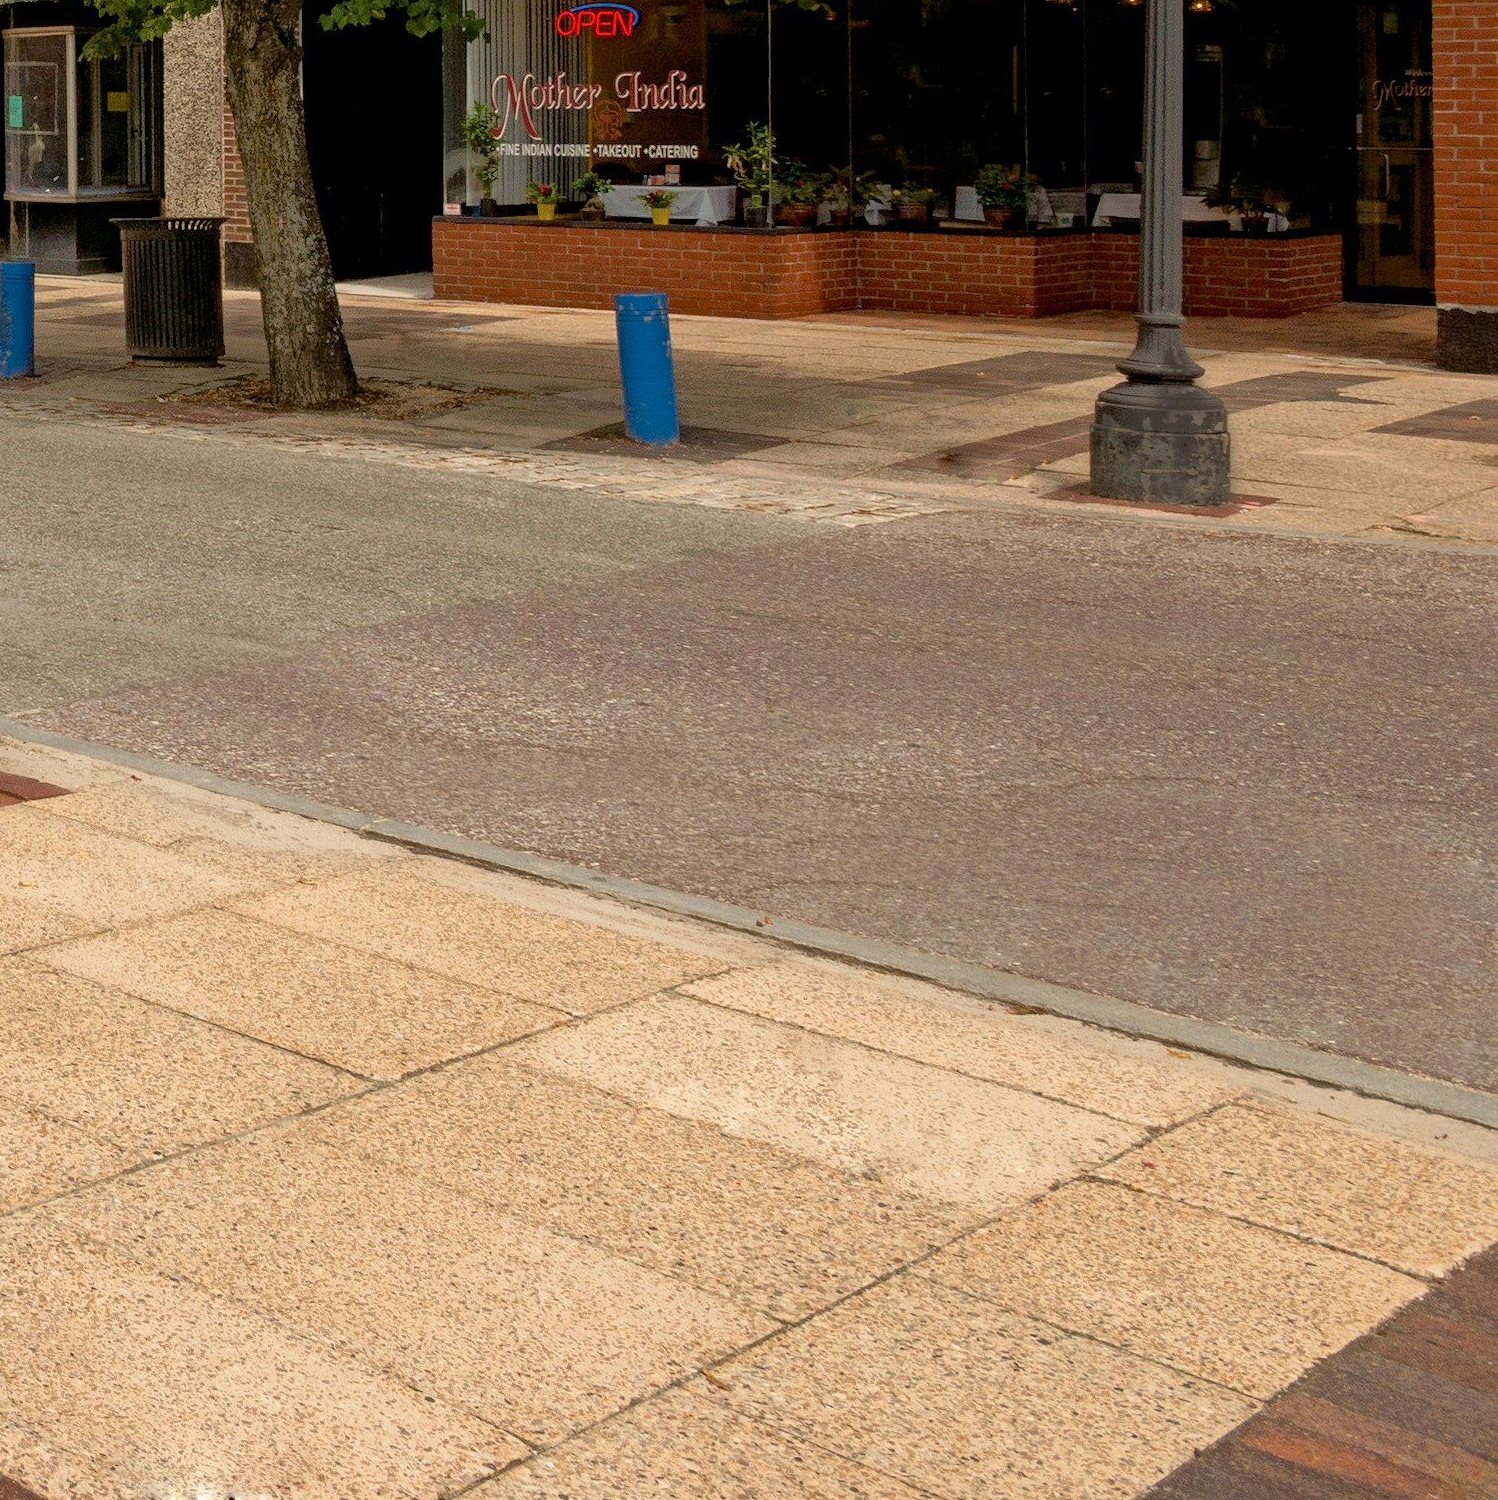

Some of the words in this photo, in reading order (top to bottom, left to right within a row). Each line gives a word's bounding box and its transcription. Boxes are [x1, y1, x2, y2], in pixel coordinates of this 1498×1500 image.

[556, 10, 634, 36] OPEN
[490, 71, 602, 141] Mother
[615, 70, 706, 112] India
[499, 145, 520, 157] FINE
[522, 145, 553, 157] INDIAN
[554, 145, 591, 157] CUISINE
